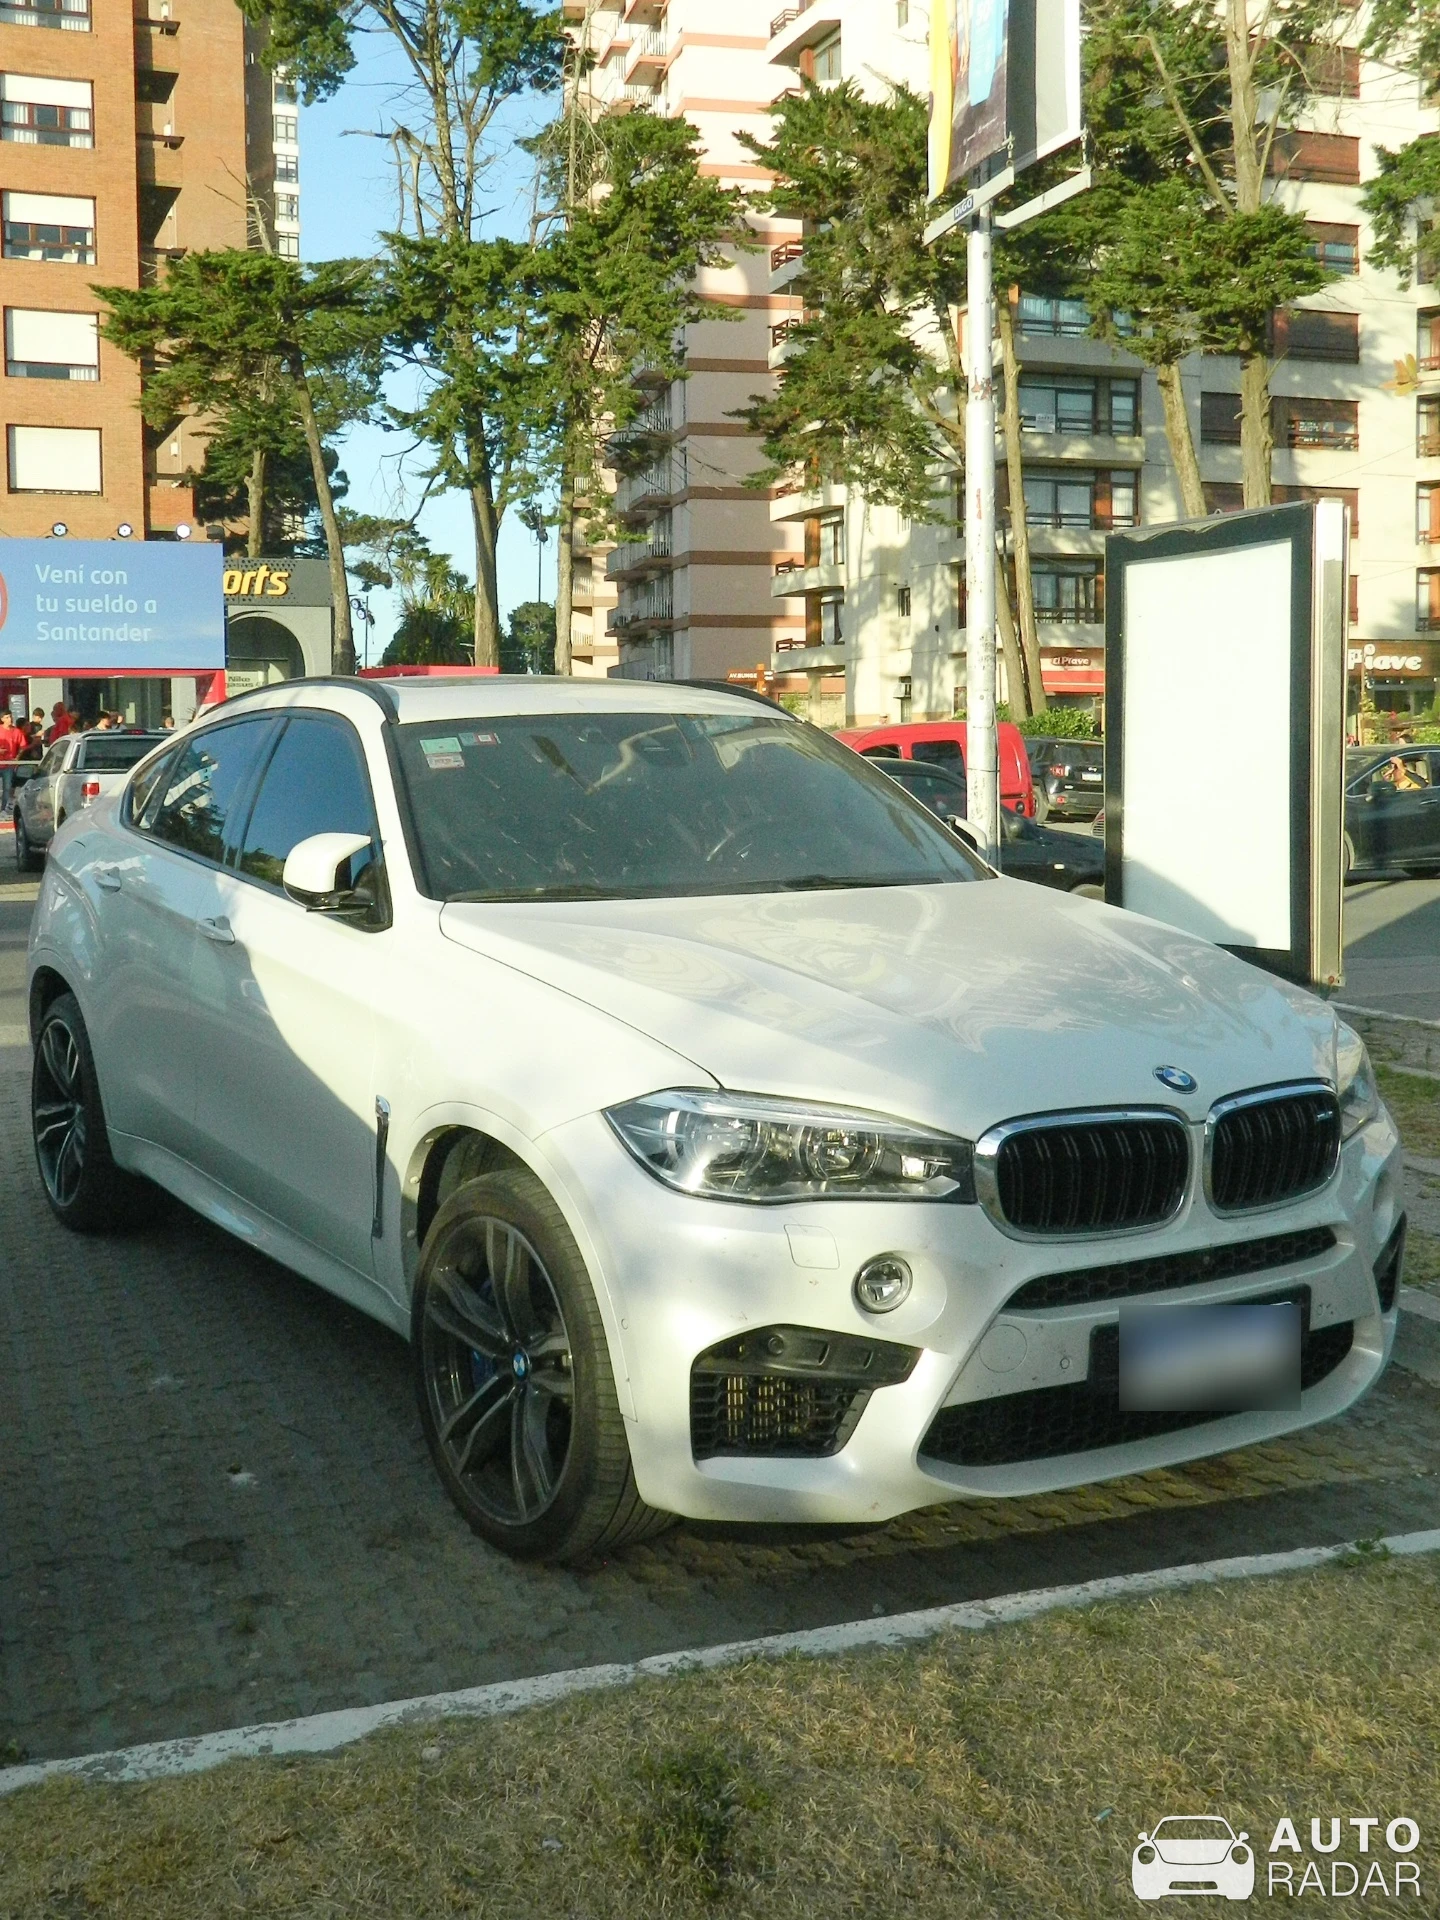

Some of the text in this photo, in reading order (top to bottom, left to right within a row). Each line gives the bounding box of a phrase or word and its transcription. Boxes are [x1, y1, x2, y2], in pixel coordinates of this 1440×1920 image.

[35, 564, 128, 585] Vení con
[36, 594, 157, 614] tu sueldo a
[36, 621, 152, 642] Santander
[1062, 656, 1089, 665] Piave
[1347, 643, 1422, 671] Piave
